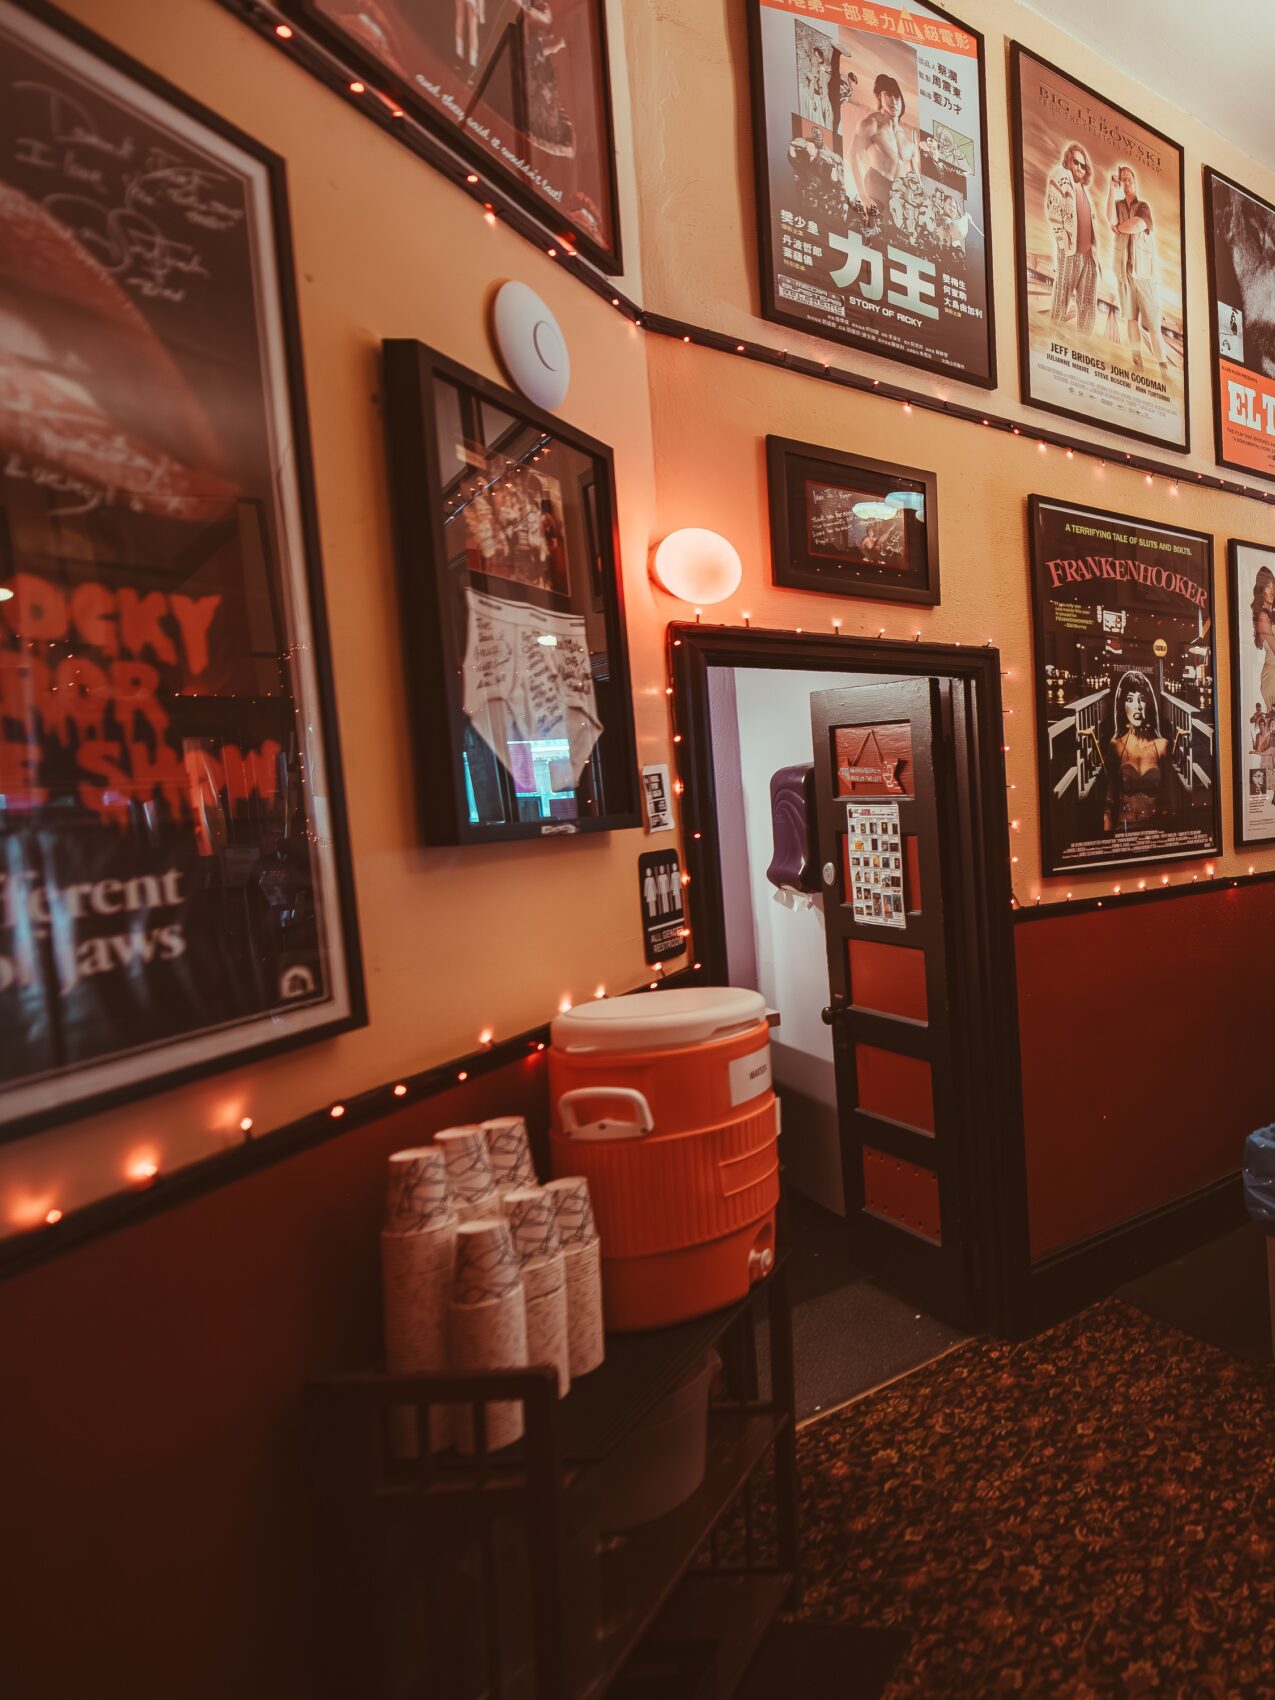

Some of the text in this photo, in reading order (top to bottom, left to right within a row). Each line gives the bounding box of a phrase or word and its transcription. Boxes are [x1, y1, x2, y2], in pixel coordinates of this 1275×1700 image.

[1039, 86, 1162, 166] BIG LEBOWSKI
[828, 230, 940, 320] 力王
[849, 296, 880, 313] STORY
[881, 307, 895, 318] OF
[896, 312, 923, 328] RICKY
[1046, 353, 1071, 368] JULIANNE
[1072, 361, 1089, 374] MOORE
[1094, 370, 1109, 381] STEVE
[1110, 376, 1132, 389] BUSCEMI
[1050, 342, 1167, 393] JEFF BRIDGES JOHN GOODMAN
[1227, 379, 1262, 431] EL
[1064, 523, 1193, 556] A TERRIFYING TALE OF SLUTS AND BOLTS.
[1045, 555, 1208, 609] FRANKENHOOKER
[1113, 664, 1130, 673] TIMES
[651, 933, 662, 943] ALL
